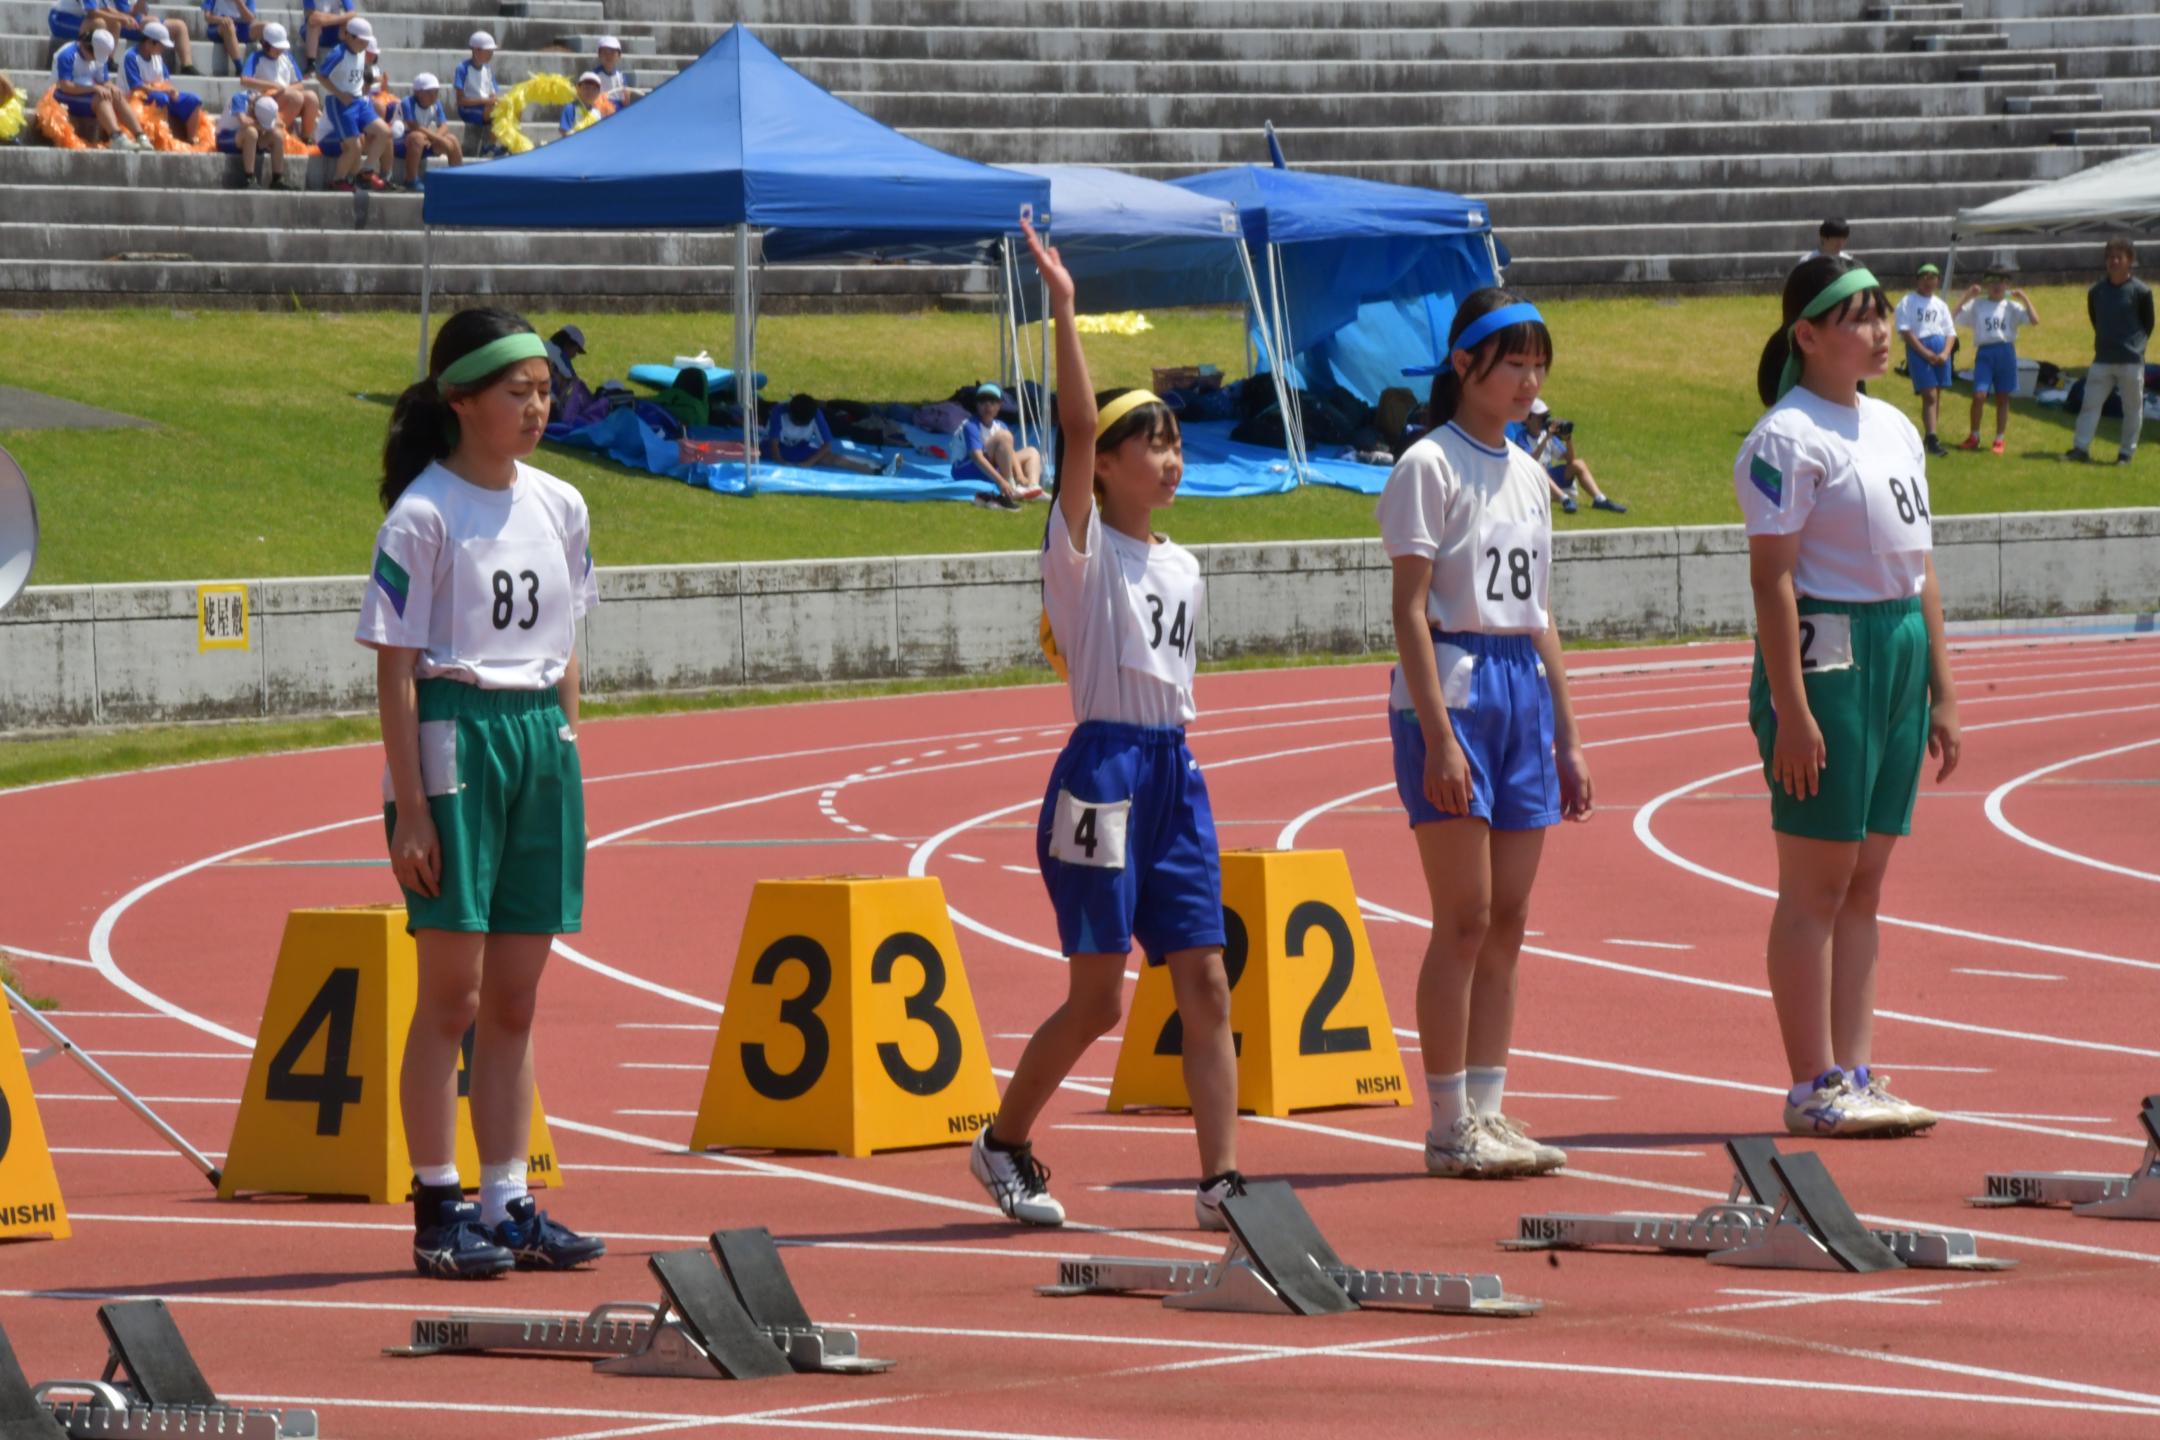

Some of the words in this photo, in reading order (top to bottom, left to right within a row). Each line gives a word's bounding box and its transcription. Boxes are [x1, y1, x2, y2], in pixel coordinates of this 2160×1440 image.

[1917, 309, 1937, 322] 587
[1889, 476, 1930, 525] 84
[492, 569, 539, 630] 83
[1486, 546, 1538, 602] 28
[1799, 621, 1818, 668] 2
[1074, 808, 1098, 858] 4
[1284, 900, 1372, 1056] 2
[740, 934, 832, 1100] 3
[871, 931, 962, 1096] 3
[264, 967, 364, 1136] 4
[1355, 1075, 1401, 1094] NISHI
[416, 1320, 470, 1345] NISHI
